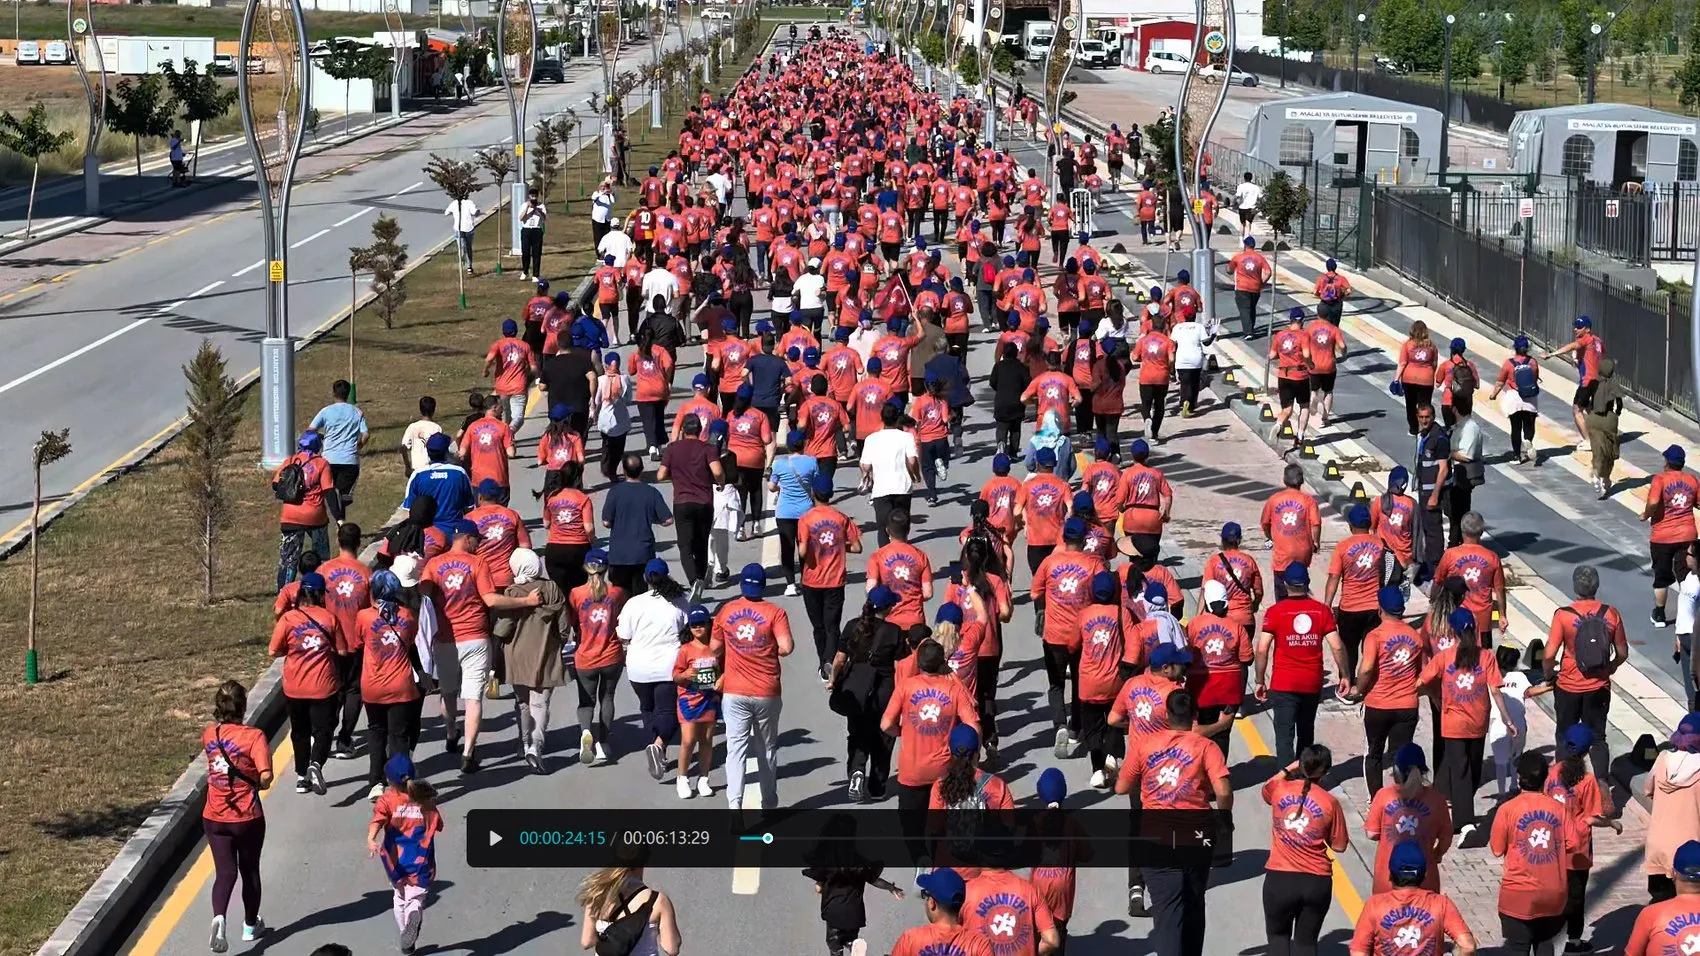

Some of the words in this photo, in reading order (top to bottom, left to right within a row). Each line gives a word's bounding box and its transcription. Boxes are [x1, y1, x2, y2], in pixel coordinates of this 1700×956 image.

[639, 211, 651, 224] 10
[1288, 639, 1318, 647] MALATYA
[975, 892, 1030, 919] ARSLANTEPE
